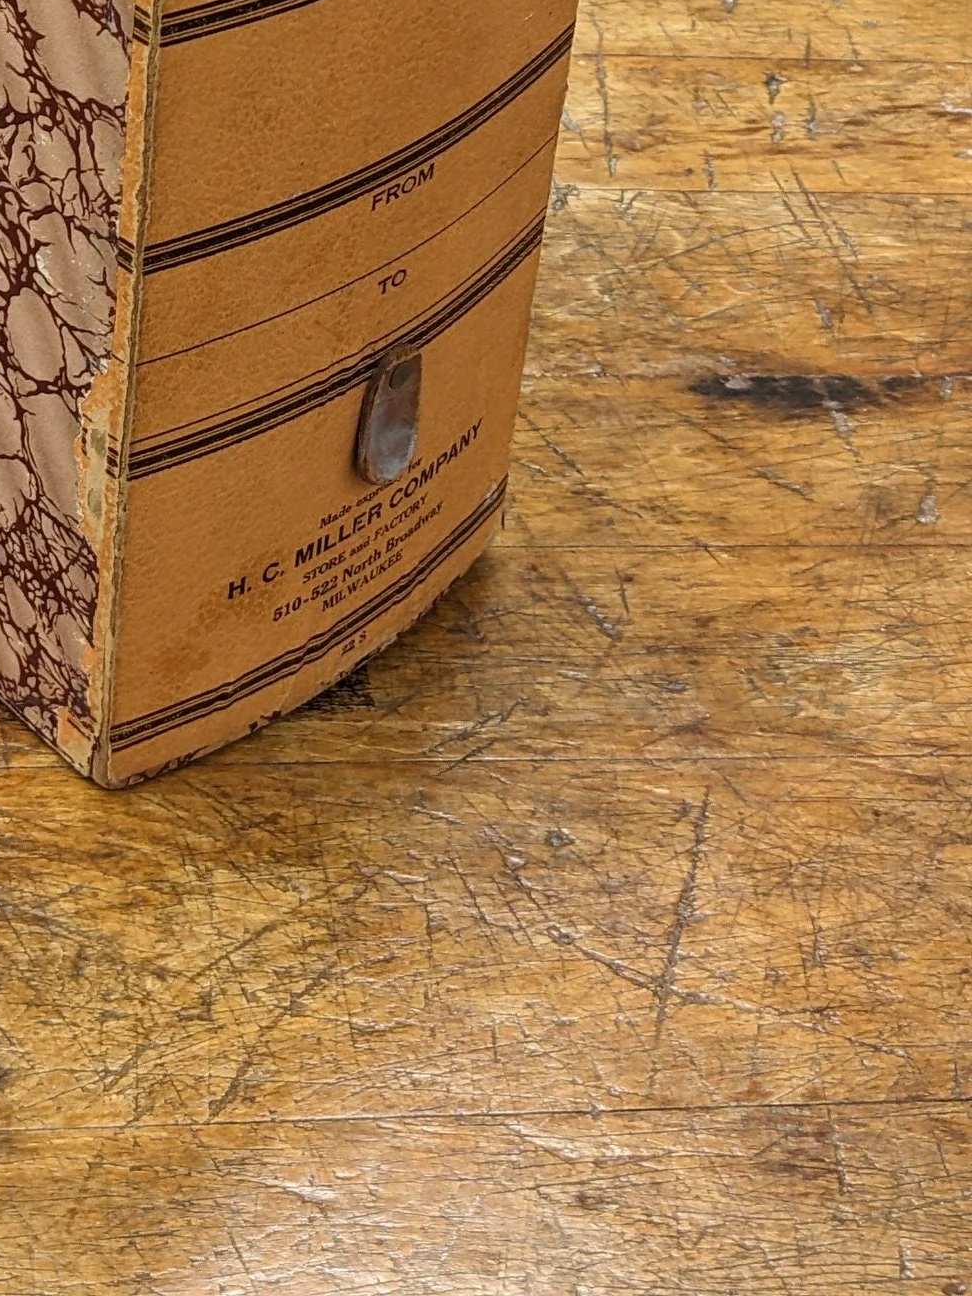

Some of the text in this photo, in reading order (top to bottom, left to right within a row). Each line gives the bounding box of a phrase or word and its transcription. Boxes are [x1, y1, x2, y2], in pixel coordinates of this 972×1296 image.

[371, 162, 435, 212] FROM
[378, 269, 407, 295] TO
[228, 415, 484, 600] H. C. MILLER COMPANY
[302, 491, 428, 584] STORE and FACTORY
[319, 505, 353, 529] Made
[272, 500, 444, 623] 510-522 North Broadway
[321, 547, 404, 613] MILWAUKEE
